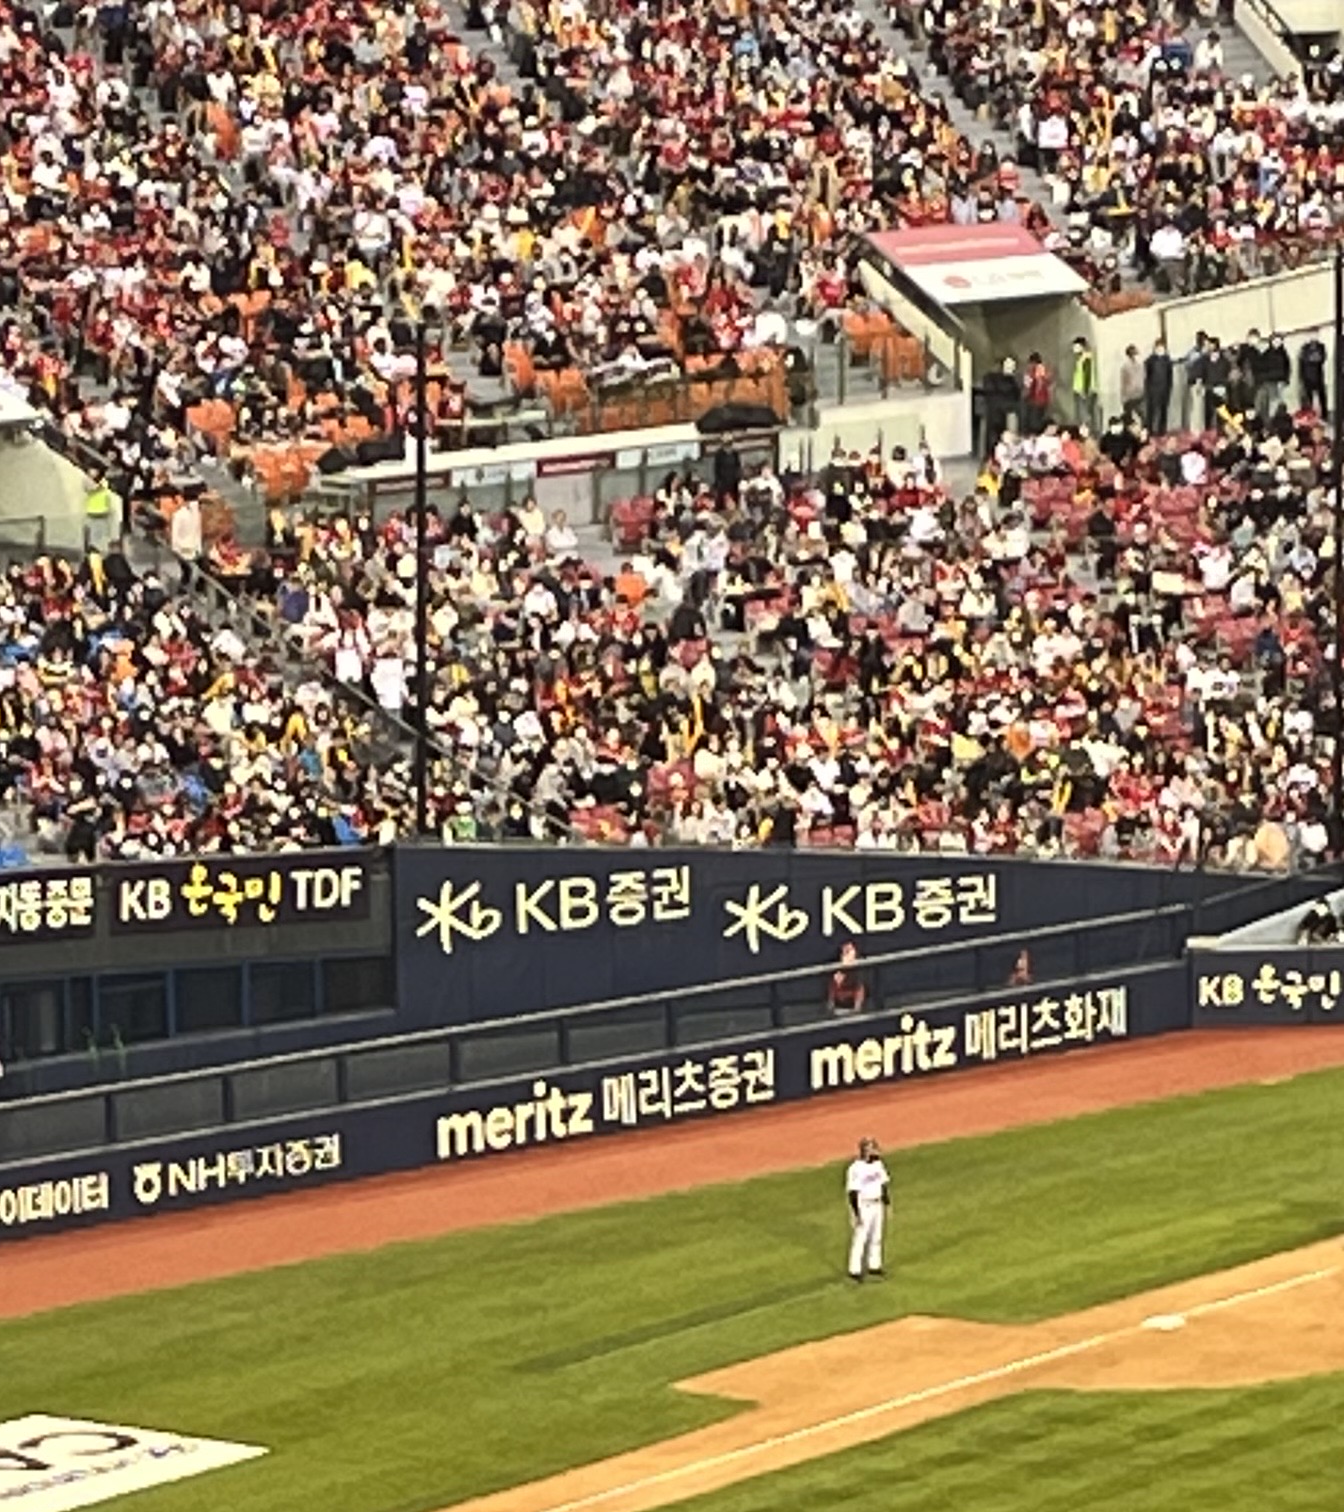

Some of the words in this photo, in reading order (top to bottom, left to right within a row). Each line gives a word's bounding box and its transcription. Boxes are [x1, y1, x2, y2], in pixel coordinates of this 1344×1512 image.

[120, 879, 172, 922] KB
[181, 864, 282, 924] 온국민
[289, 867, 362, 910] TDF
[1198, 974, 1244, 1006] KB
[1252, 964, 1340, 1010] 온국민
[810, 1014, 957, 1090] meritz
[965, 986, 1127, 1060] 메리츠화재
[436, 1080, 593, 1158] meritz
[602, 1048, 776, 1126] 메리츠증권
[168, 1133, 343, 1196] NH투자증권
